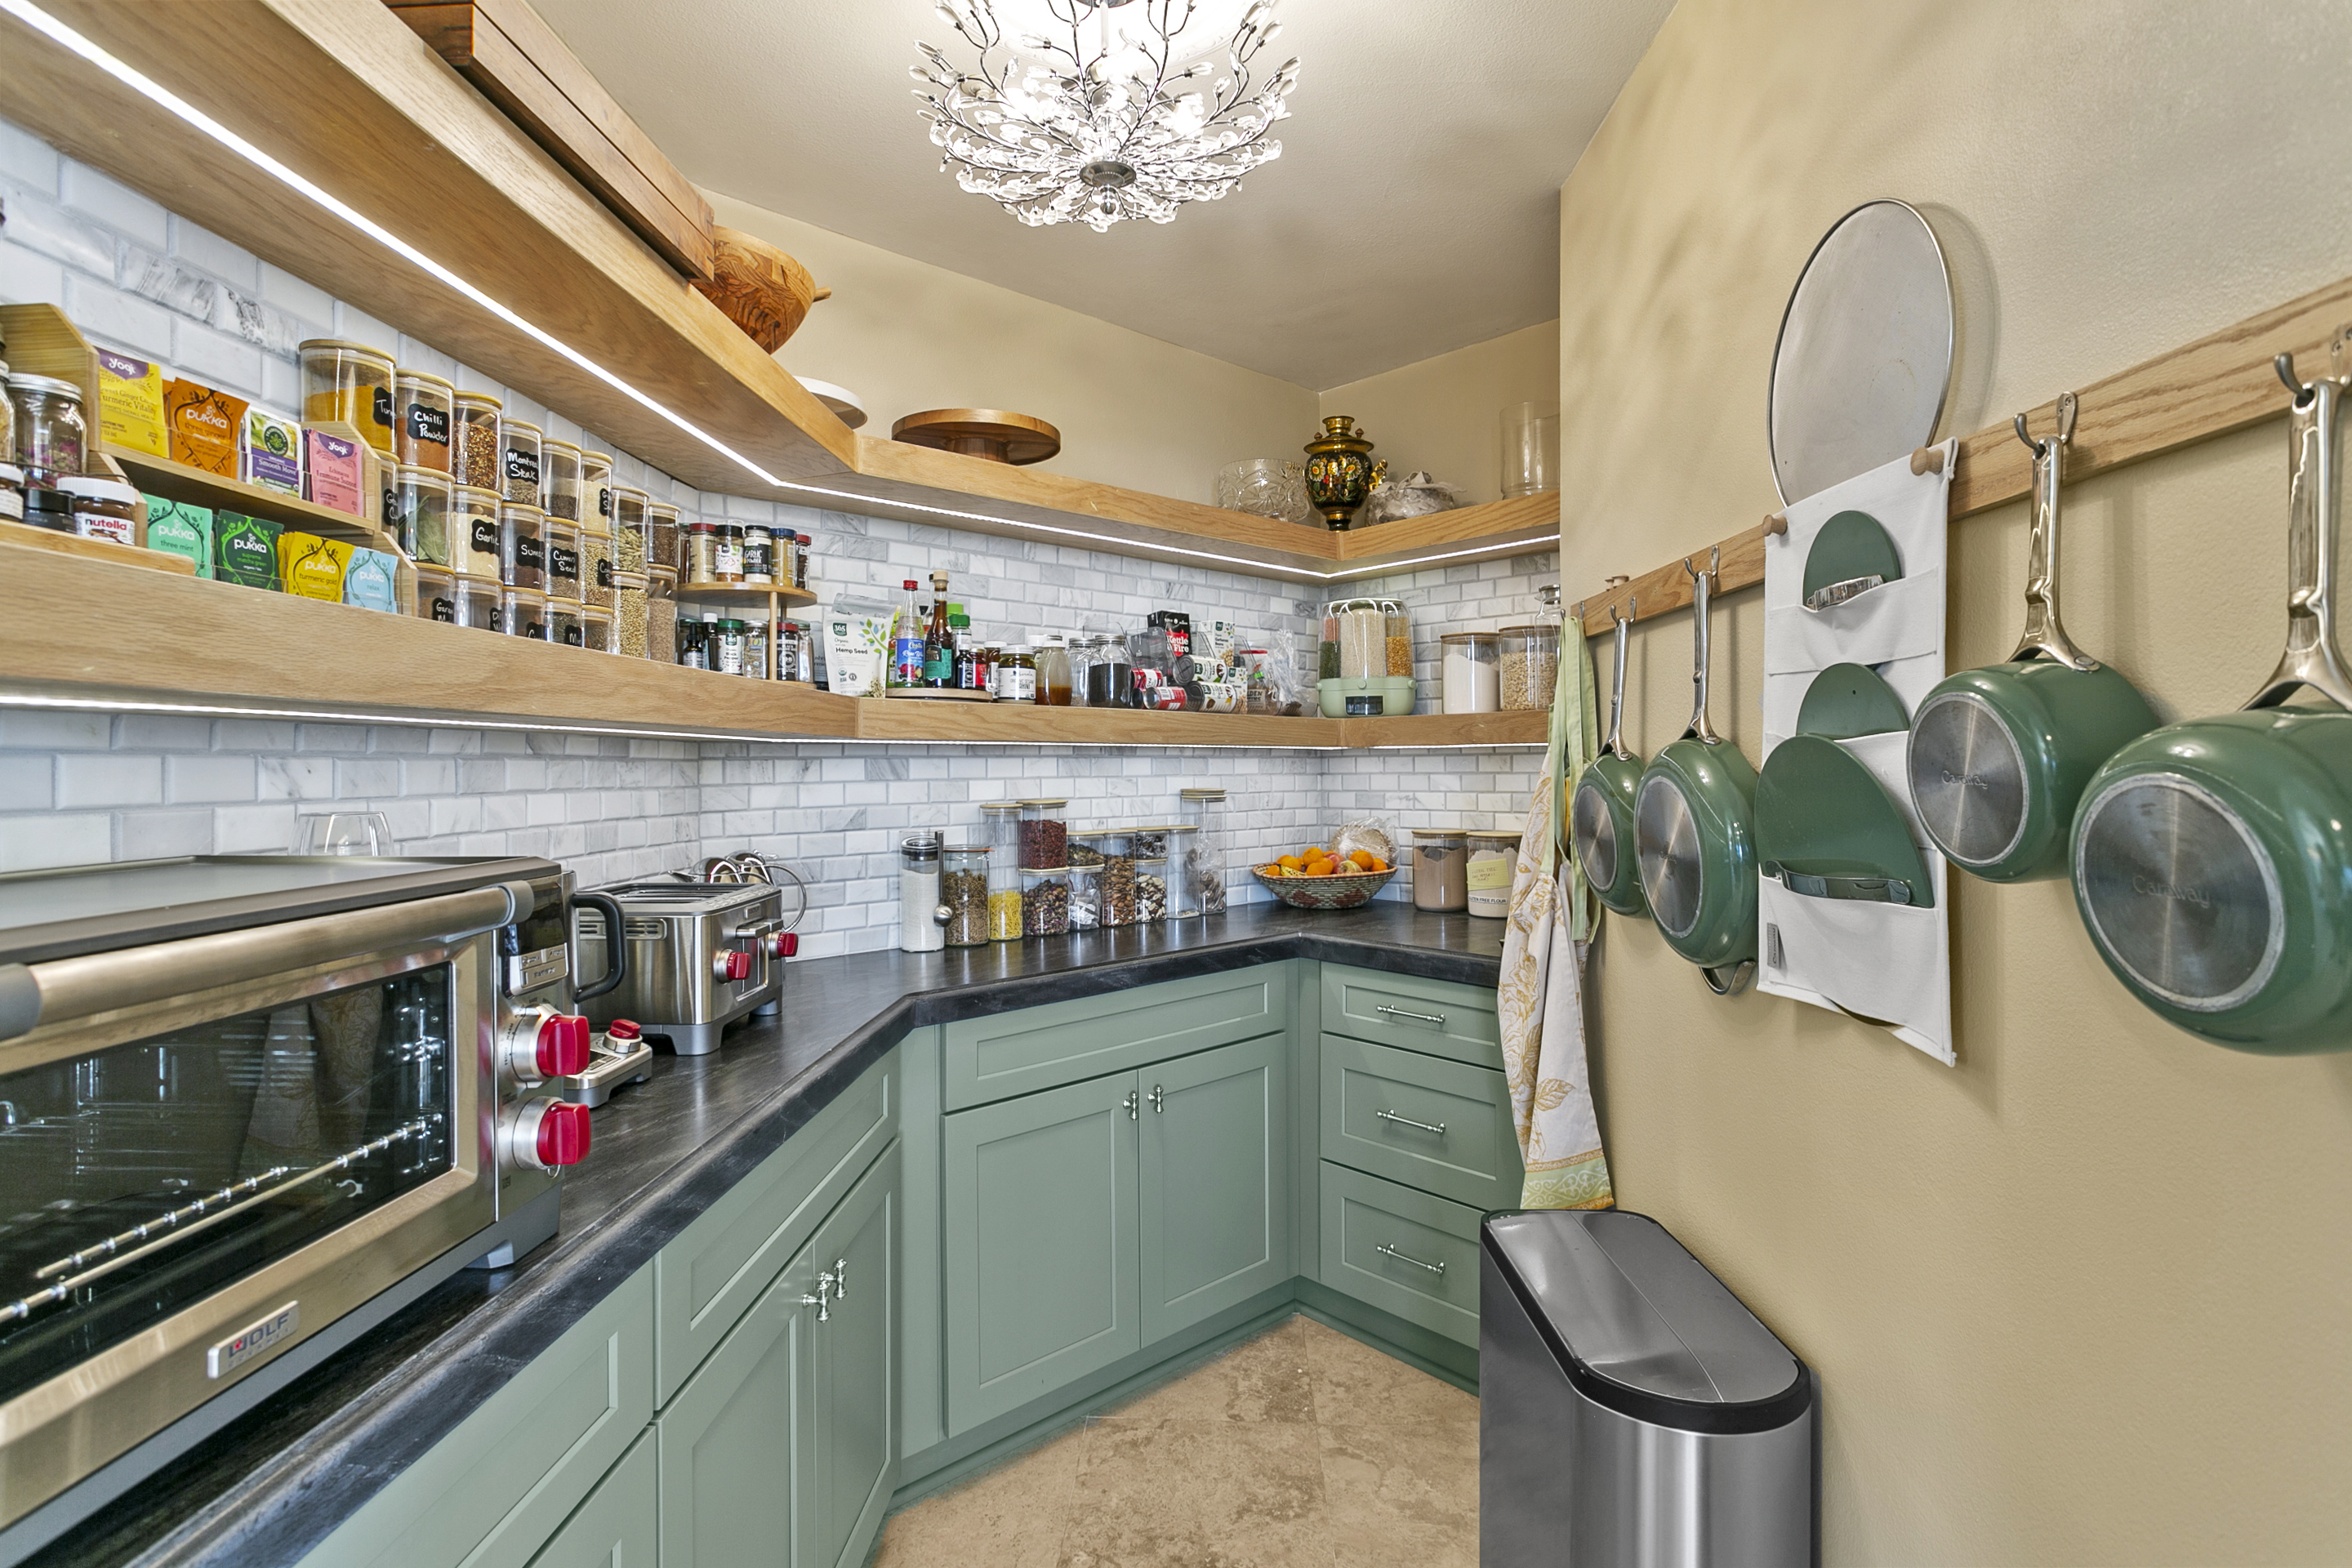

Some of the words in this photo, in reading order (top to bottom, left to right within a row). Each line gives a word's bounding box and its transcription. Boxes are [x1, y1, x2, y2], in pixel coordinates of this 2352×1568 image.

[109, 358, 136, 375] yogi
[133, 400, 157, 416] Vitality
[186, 408, 228, 429] pukka
[414, 411, 443, 425] Chilli
[419, 423, 448, 443] Powder
[328, 441, 349, 455] yogi
[258, 458, 282, 471] Smooth
[85, 518, 127, 531] nutella
[158, 524, 195, 541] pukka
[475, 527, 500, 546] Garlic
[160, 540, 179, 550] three
[180, 544, 194, 552] mint
[234, 538, 267, 554] pukka
[745, 550, 763, 559] GARLIC
[305, 560, 336, 574] pukka
[299, 573, 325, 583] turmeric
[325, 577, 337, 586] gold
[359, 571, 385, 583] pukka
[1167, 635, 1189, 645] Kettle
[835, 647, 853, 655] Hemp
[1174, 644, 1189, 653] Fire
[1941, 770, 1988, 790] Caraway
[2132, 875, 2210, 909] Caraway
[229, 1312, 290, 1359] WOLF
